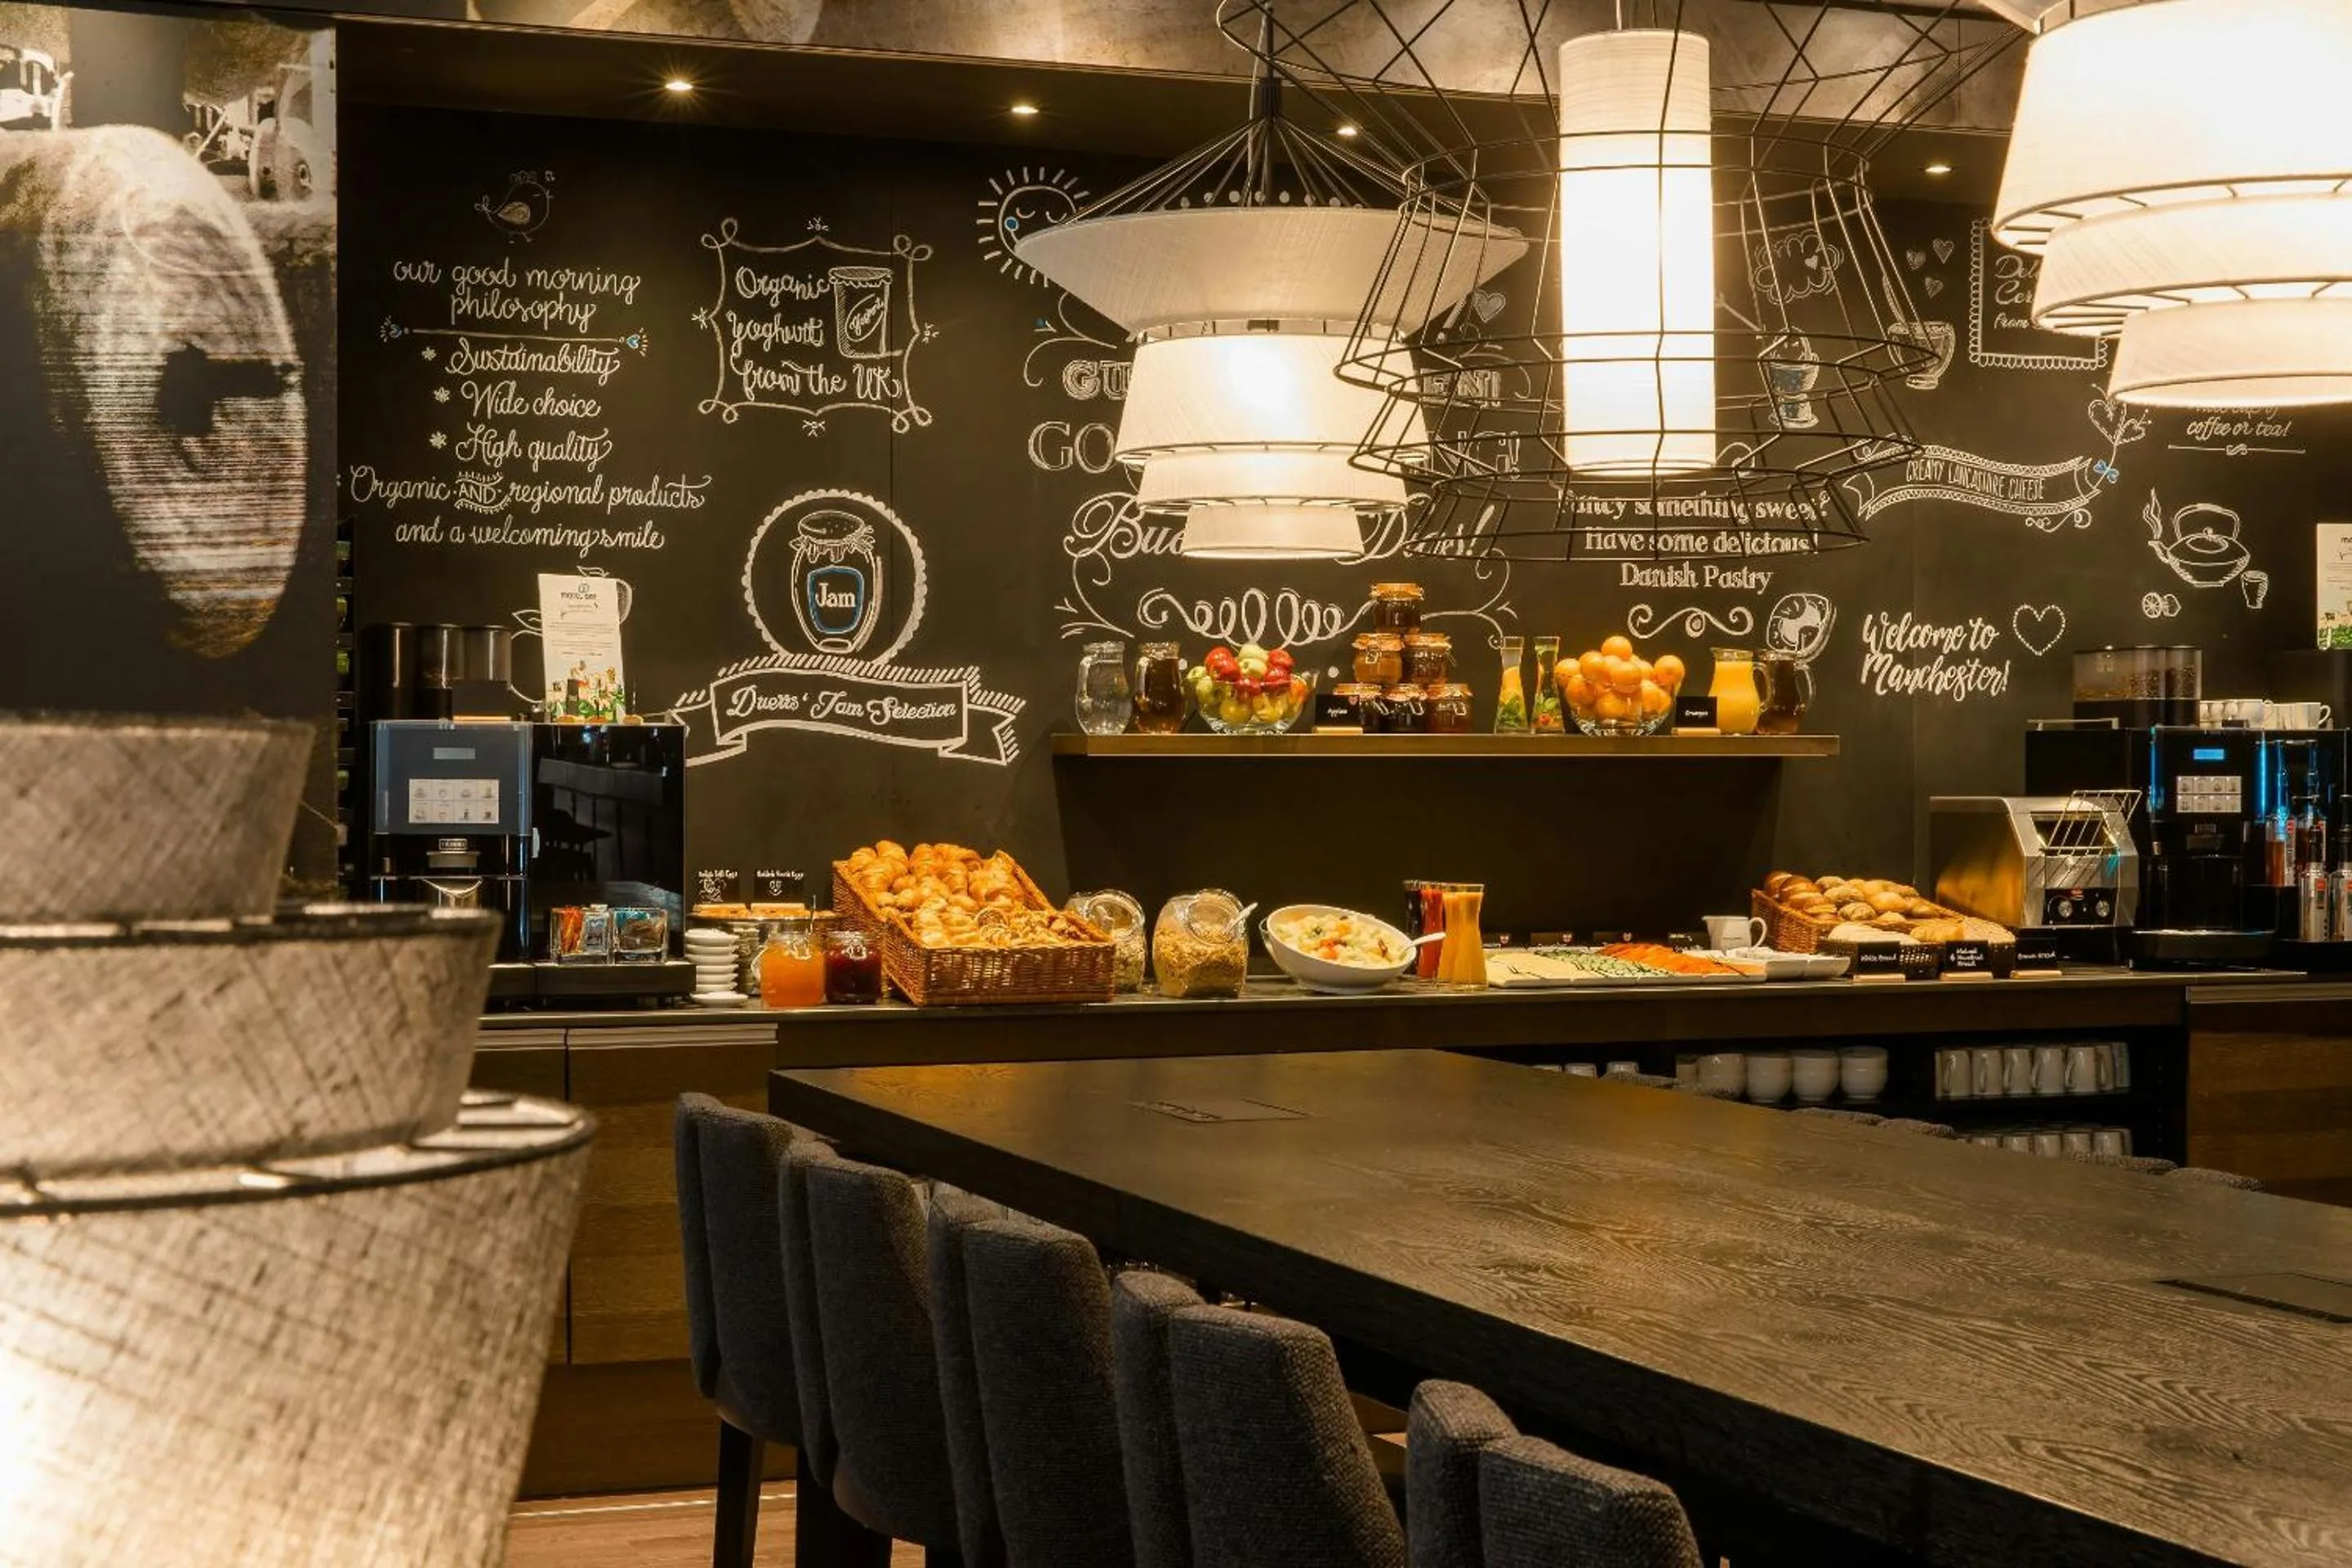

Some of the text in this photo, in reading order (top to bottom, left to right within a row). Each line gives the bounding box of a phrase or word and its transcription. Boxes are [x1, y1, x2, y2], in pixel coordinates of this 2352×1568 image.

[393, 256, 641, 305] our good morning
[736, 265, 830, 308] Organic
[451, 287, 597, 333] philosophy
[445, 336, 621, 386] Sustainability
[730, 359, 902, 402] from the UK
[460, 380, 601, 420] Wide choice
[455, 421, 613, 473] High quality
[1027, 420, 1116, 474] GO
[2186, 416, 2292, 442] coffee or tea!
[350, 464, 714, 514] Organic AND regional products
[1905, 458, 1945, 483] CREAMY
[2007, 476, 2047, 501] CHEESE
[395, 515, 666, 558] and a welcoming smile
[1062, 491, 1189, 559] Bue
[1584, 527, 1645, 551] Have
[814, 582, 857, 609] Jam
[1619, 560, 1774, 595] Danish Pastry
[1861, 611, 2000, 654] Welcome to
[1860, 653, 2011, 702] Manchester!
[809, 690, 865, 719] Jam
[866, 696, 957, 726] Selection
